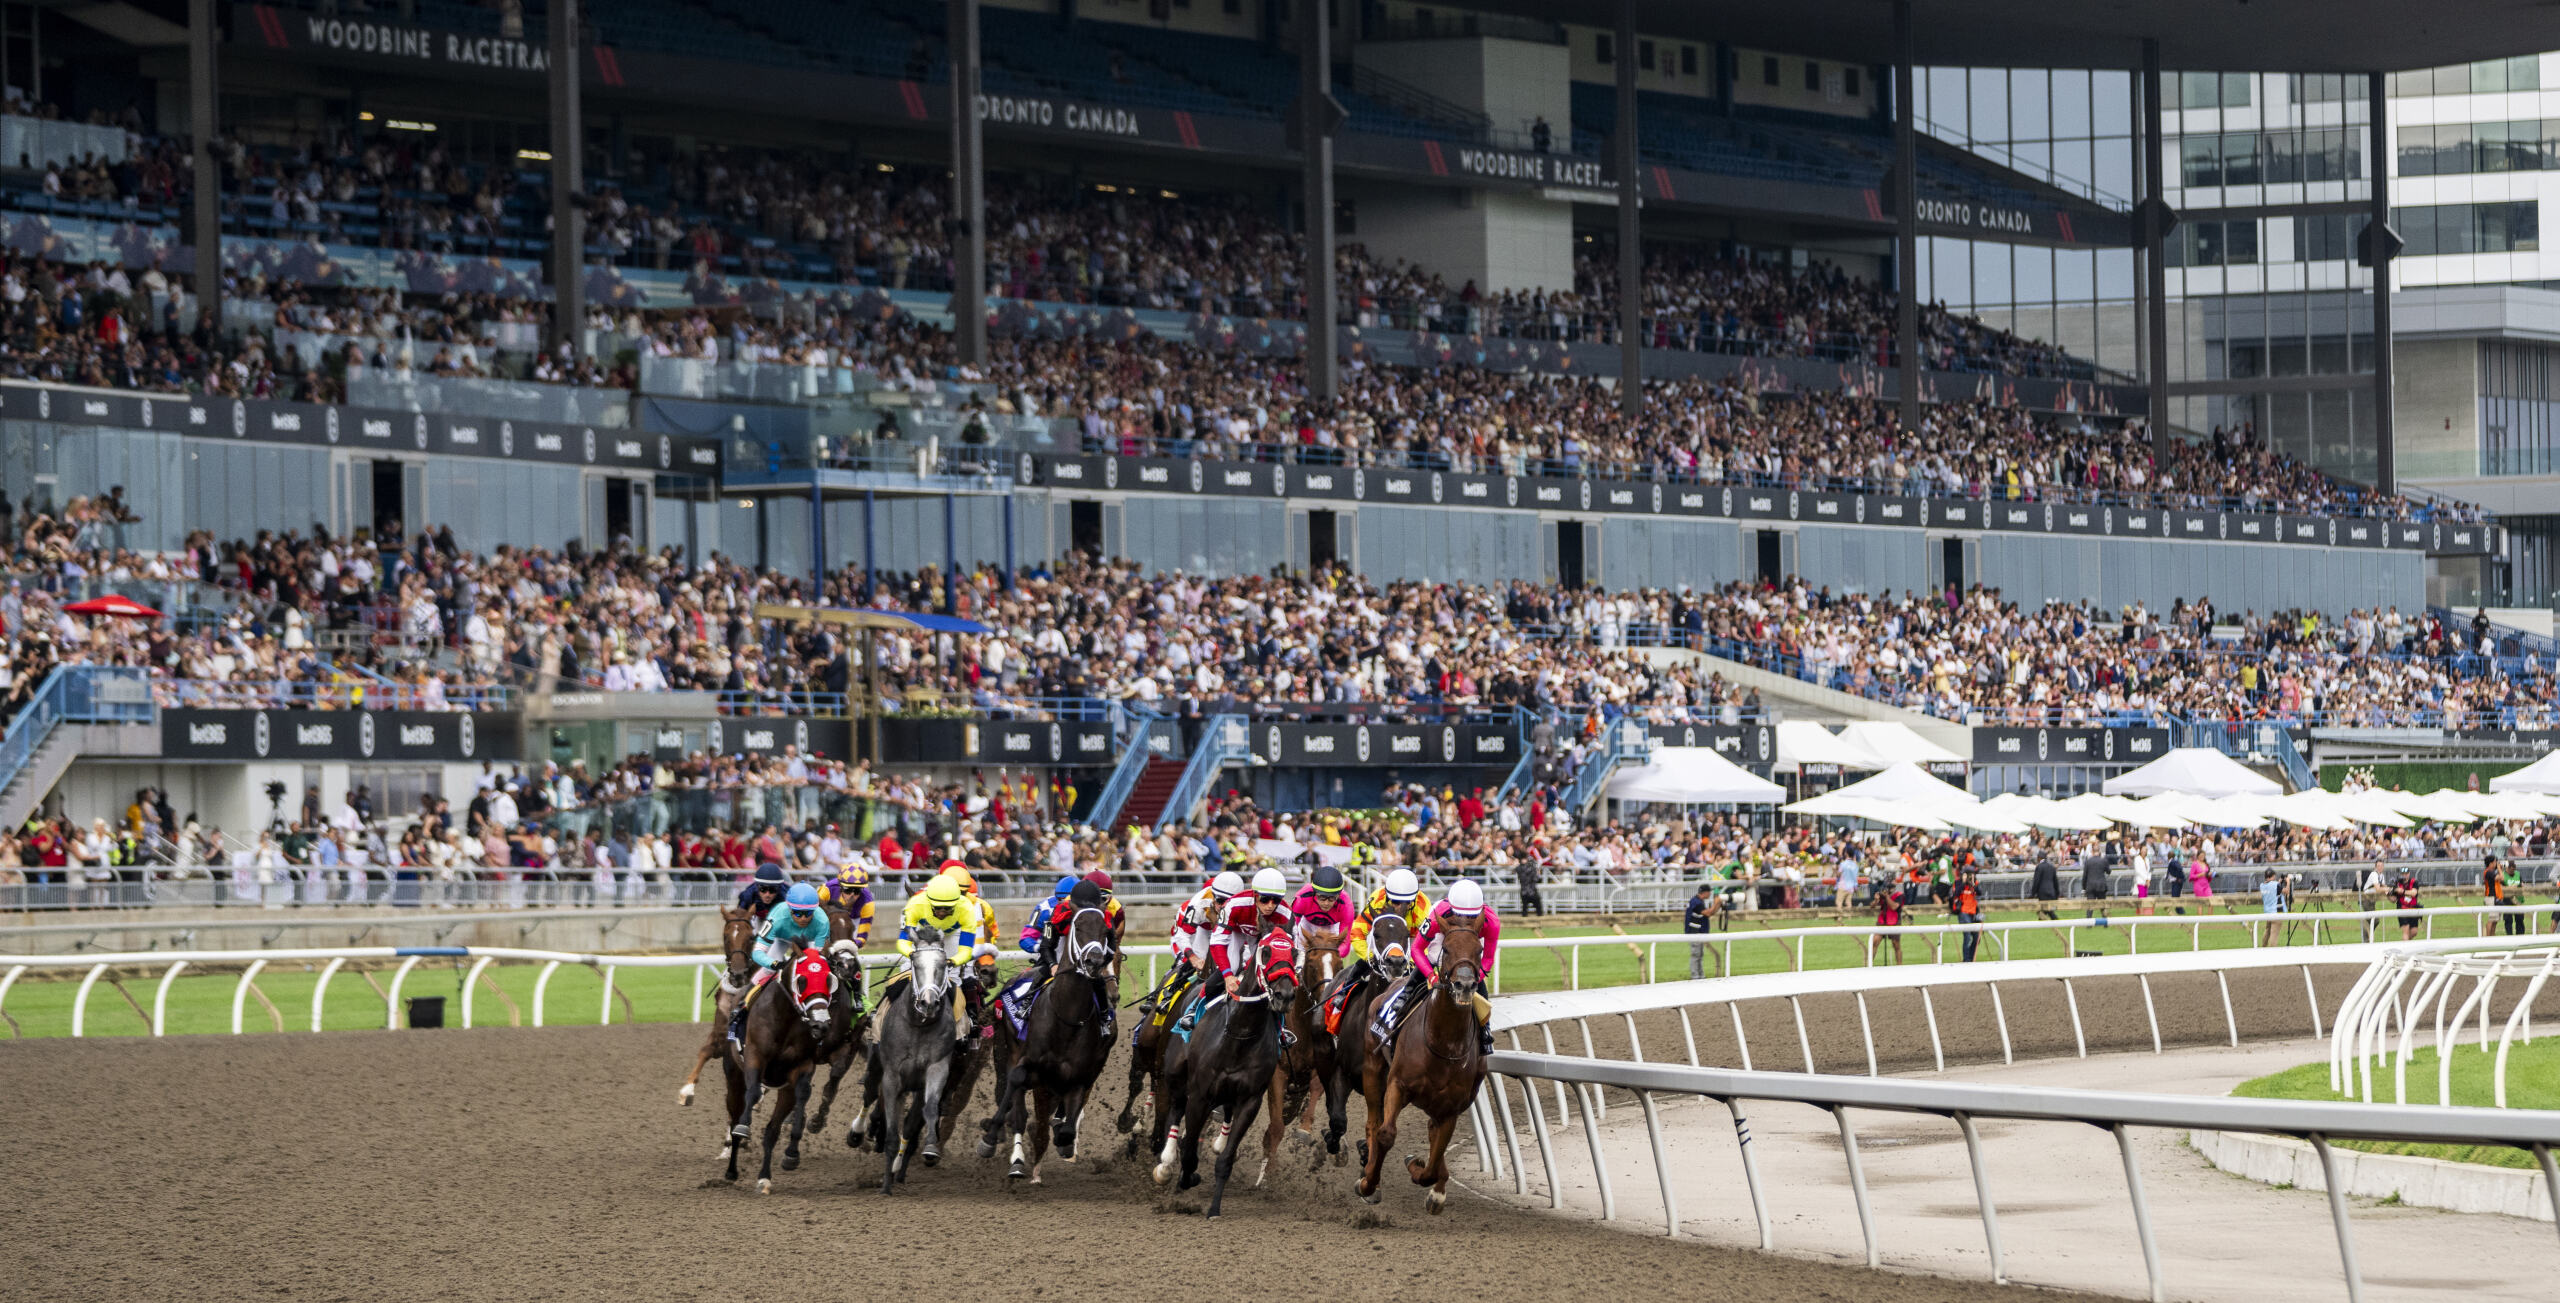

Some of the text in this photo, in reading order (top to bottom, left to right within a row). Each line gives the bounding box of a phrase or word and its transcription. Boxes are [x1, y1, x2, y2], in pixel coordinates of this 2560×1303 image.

[308, 18, 550, 71] WOODBINE RACETRA
[1065, 104, 1139, 136] CANADA
[1460, 149, 1619, 188] WOODBINE RACET
[1980, 203, 2031, 233] CANADA
[1537, 486, 1562, 501] bet365
[1610, 490, 1634, 505] bet365
[1680, 493, 1704, 508] bet365
[1750, 497, 1772, 511] bet365
[1816, 501, 1838, 515] bet365
[1882, 504, 1903, 518] bet365
[1945, 507, 1966, 521] bet365
[2008, 509, 2028, 524] bet365
[2069, 513, 2089, 527] bet365
[2128, 516, 2147, 530] bet365
[2186, 519, 2204, 532] bet365
[2242, 521, 2260, 534] bet365
[2297, 524, 2315, 537] bet365
[2350, 527, 2368, 540] bet365
[2403, 529, 2420, 542] bet365
[2454, 532, 2471, 545] bet365
[190, 724, 225, 743] bet365
[298, 725, 332, 744] bet365
[401, 726, 434, 744] bet365
[745, 731, 773, 748] bet365
[1005, 734, 1030, 750] bet365
[1080, 735, 1105, 750] bet365
[1305, 736, 1334, 751] bet365
[1392, 736, 1420, 752] bet365
[1477, 736, 1504, 752] bet365
[1999, 738, 2020, 752] bet365
[2066, 738, 2086, 751] bet365
[2131, 738, 2151, 752] bet365
[1186, 908, 1196, 924] 4
